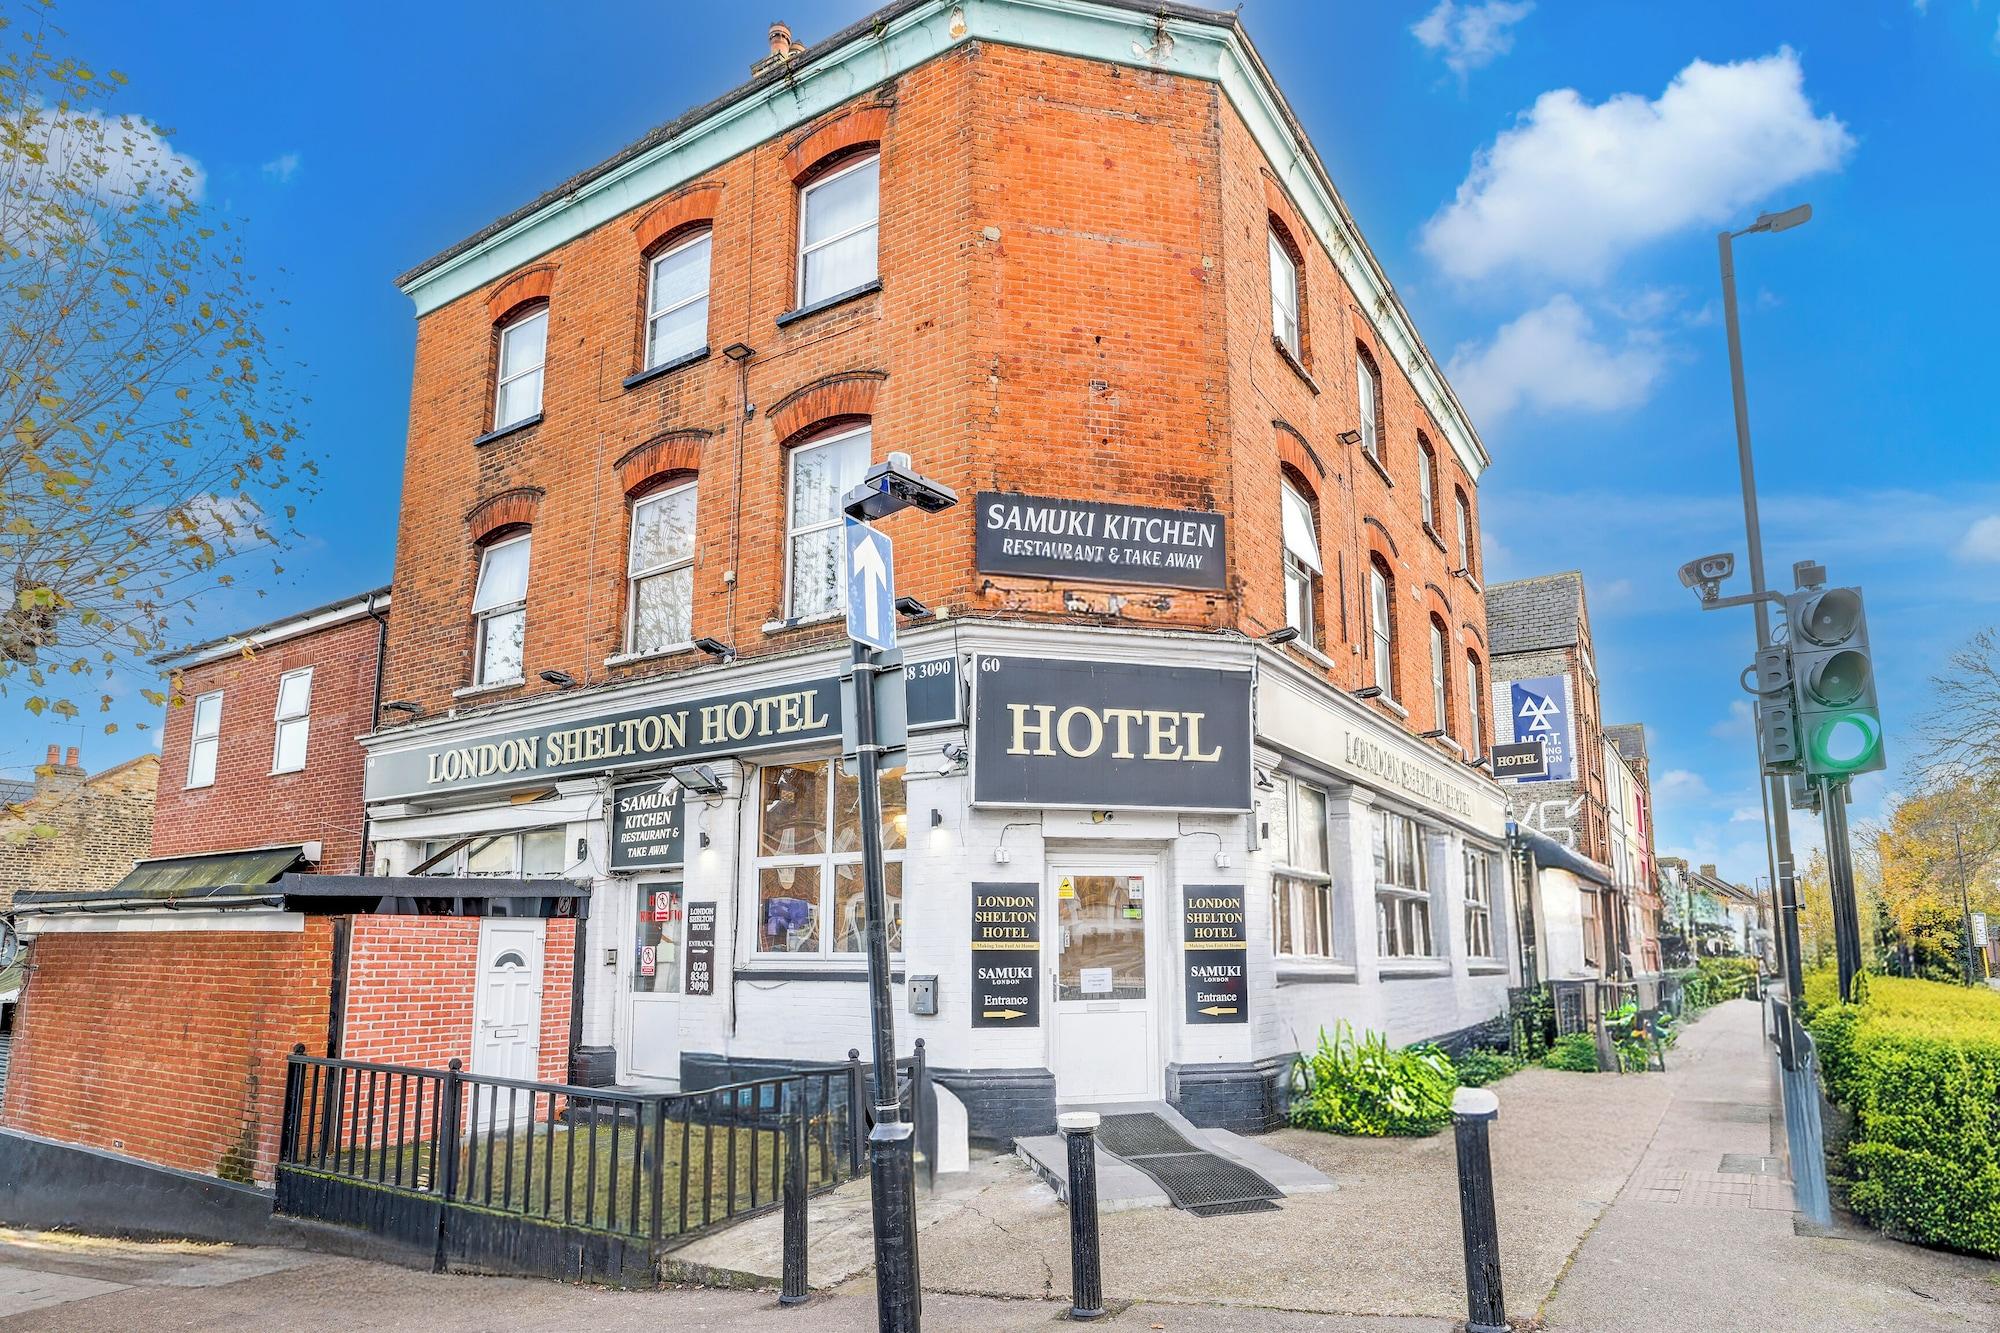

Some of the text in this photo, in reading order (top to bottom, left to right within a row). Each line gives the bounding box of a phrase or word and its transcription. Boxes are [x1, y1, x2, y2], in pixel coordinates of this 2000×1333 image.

[987, 503, 1217, 548] SAMUKI KITCHEN
[1002, 538, 1203, 569] RESTAURANT & TAKE AWAY
[919, 660, 951, 679] 3090
[981, 657, 1001, 673] 60
[427, 689, 829, 784] LONDON SHELTON HOTEL
[1006, 703, 1222, 763] HOTEL
[1521, 733, 1562, 745] MO.T.
[1496, 753, 1539, 767] HOTEL
[1345, 731, 1400, 783] LONDON
[1401, 761, 1447, 806] SHELTON
[620, 791, 678, 812] SAMUKI
[624, 811, 672, 829] KITCHEN
[620, 827, 680, 844] RESTAURANT &
[627, 844, 669, 858] TAKE AWAY
[976, 896, 1035, 907] LONDON
[1188, 898, 1240, 909] LONDON
[690, 907, 714, 915] LONDON
[975, 911, 1037, 923] SHELTON
[689, 915, 714, 923] SHELTON
[1186, 912, 1243, 924] SHELTON
[692, 923, 711, 931] HOTEL
[983, 926, 1030, 938] HOTEL
[1194, 927, 1237, 938] HOTEL
[692, 961, 707, 971] 020
[1191, 966, 1242, 977] SAMUKI
[690, 971, 709, 981] 8348
[978, 967, 1033, 979] SAMUKI
[689, 981, 709, 991] 3090
[984, 994, 1029, 1006] Entrance
[1197, 992, 1238, 1002] Entrance
